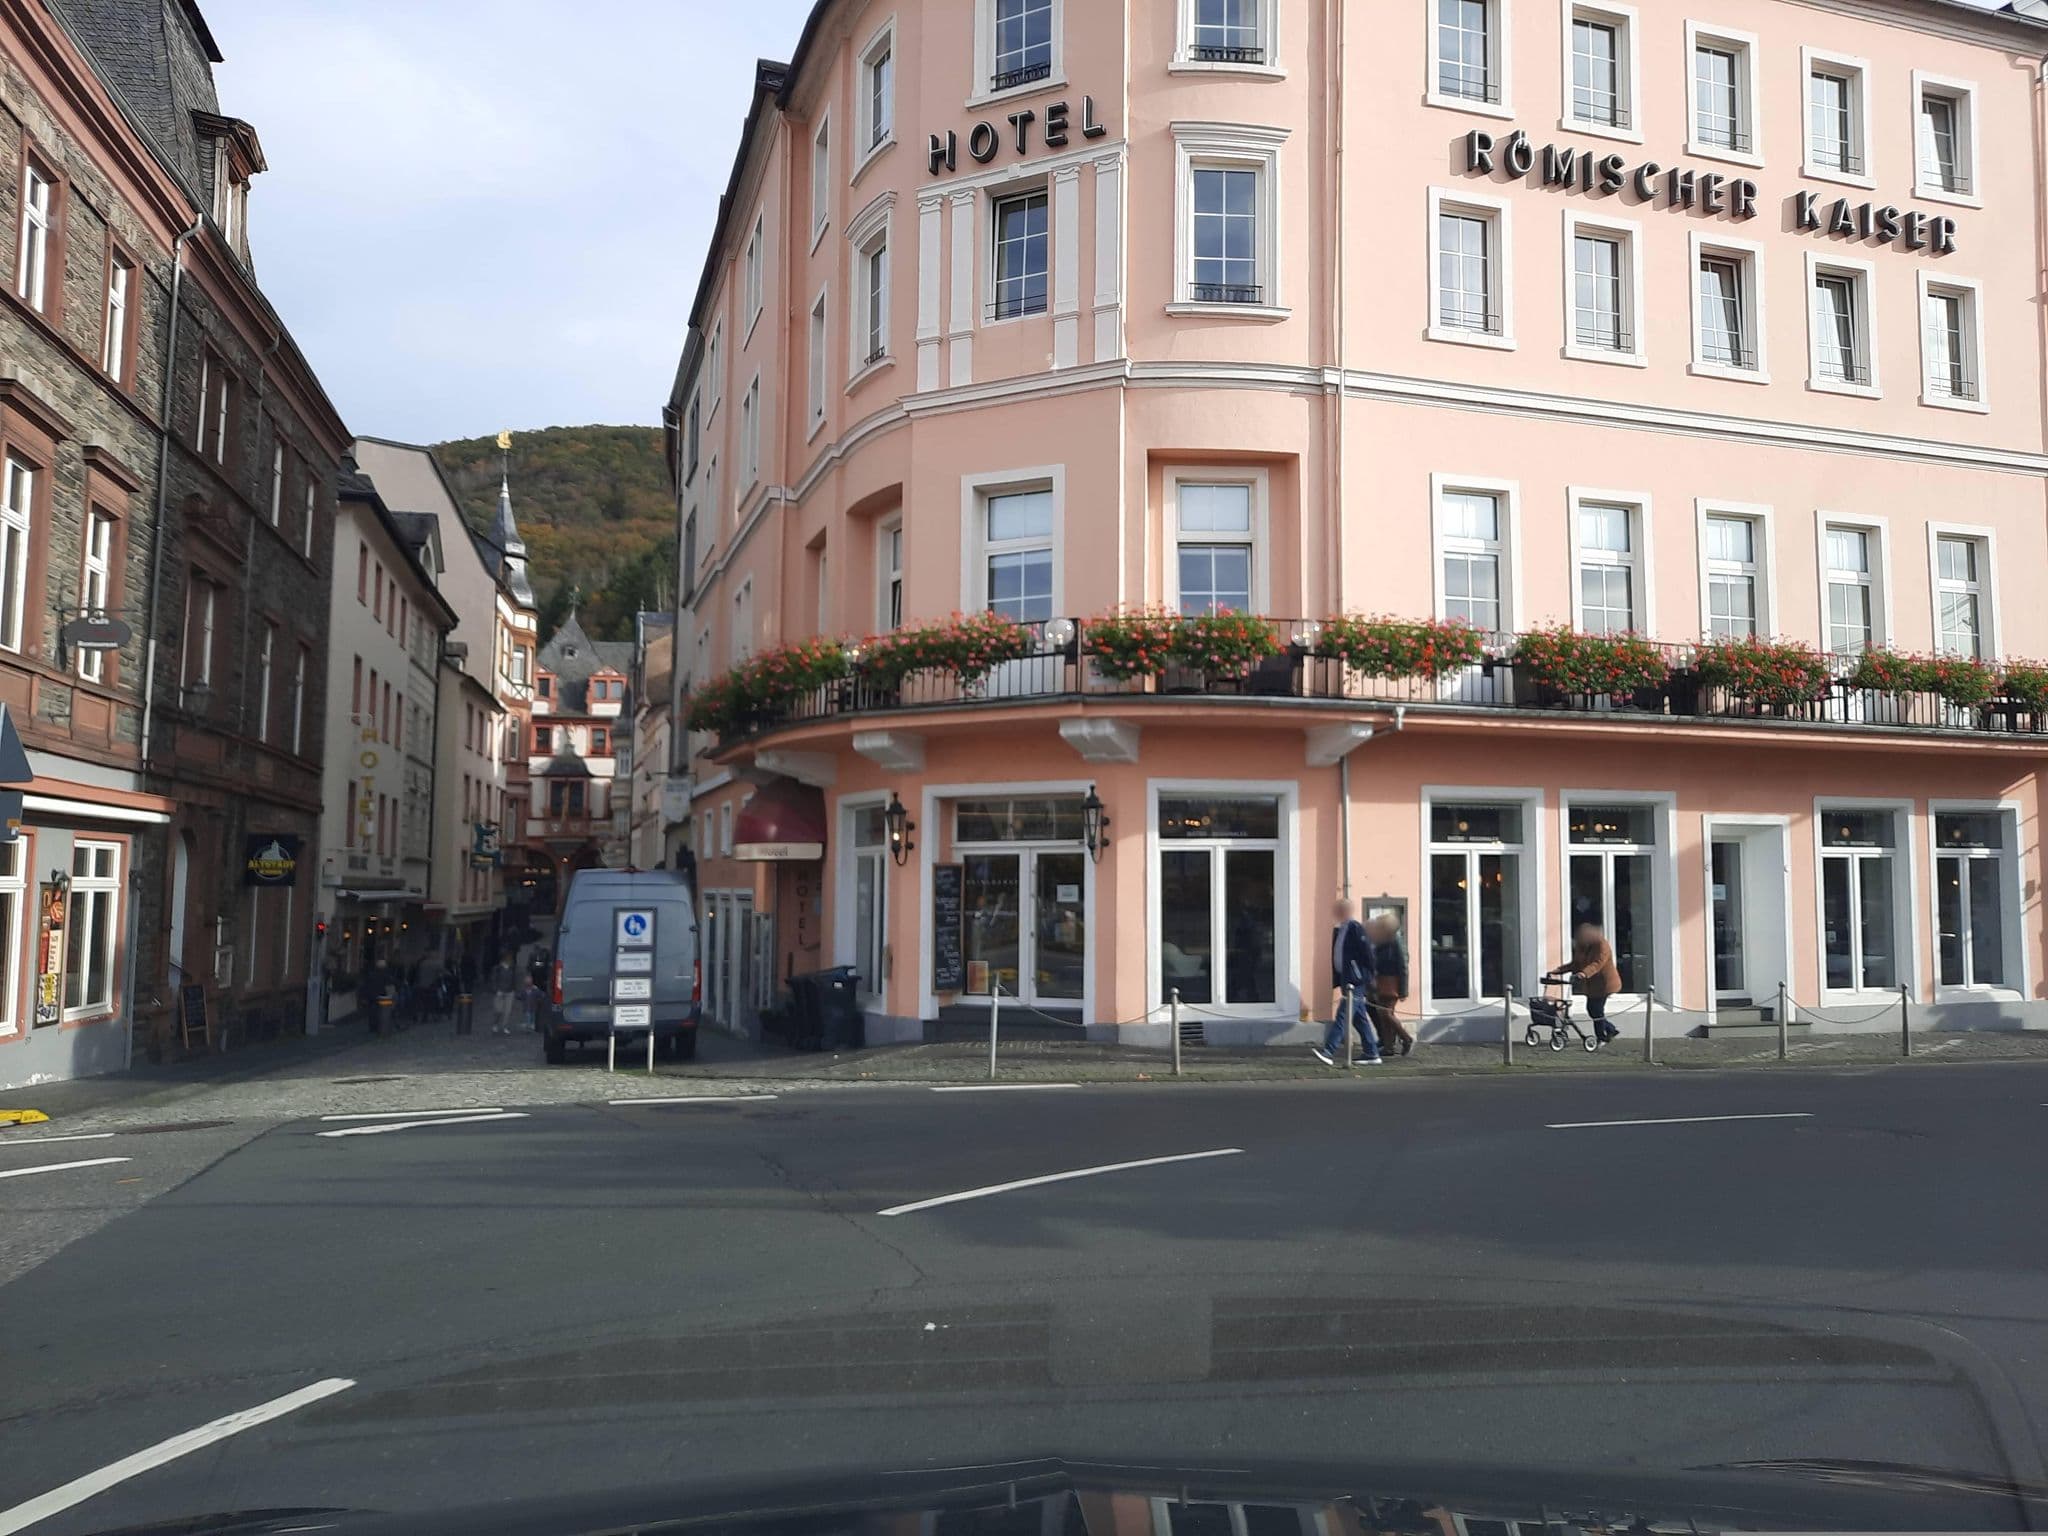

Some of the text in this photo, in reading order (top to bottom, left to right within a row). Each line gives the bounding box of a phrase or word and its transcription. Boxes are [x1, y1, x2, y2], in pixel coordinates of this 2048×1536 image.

[928, 95, 1107, 176] HOTEL
[1466, 129, 1958, 254] RÖMISCHER KAISER
[358, 727, 380, 838] HOTEL
